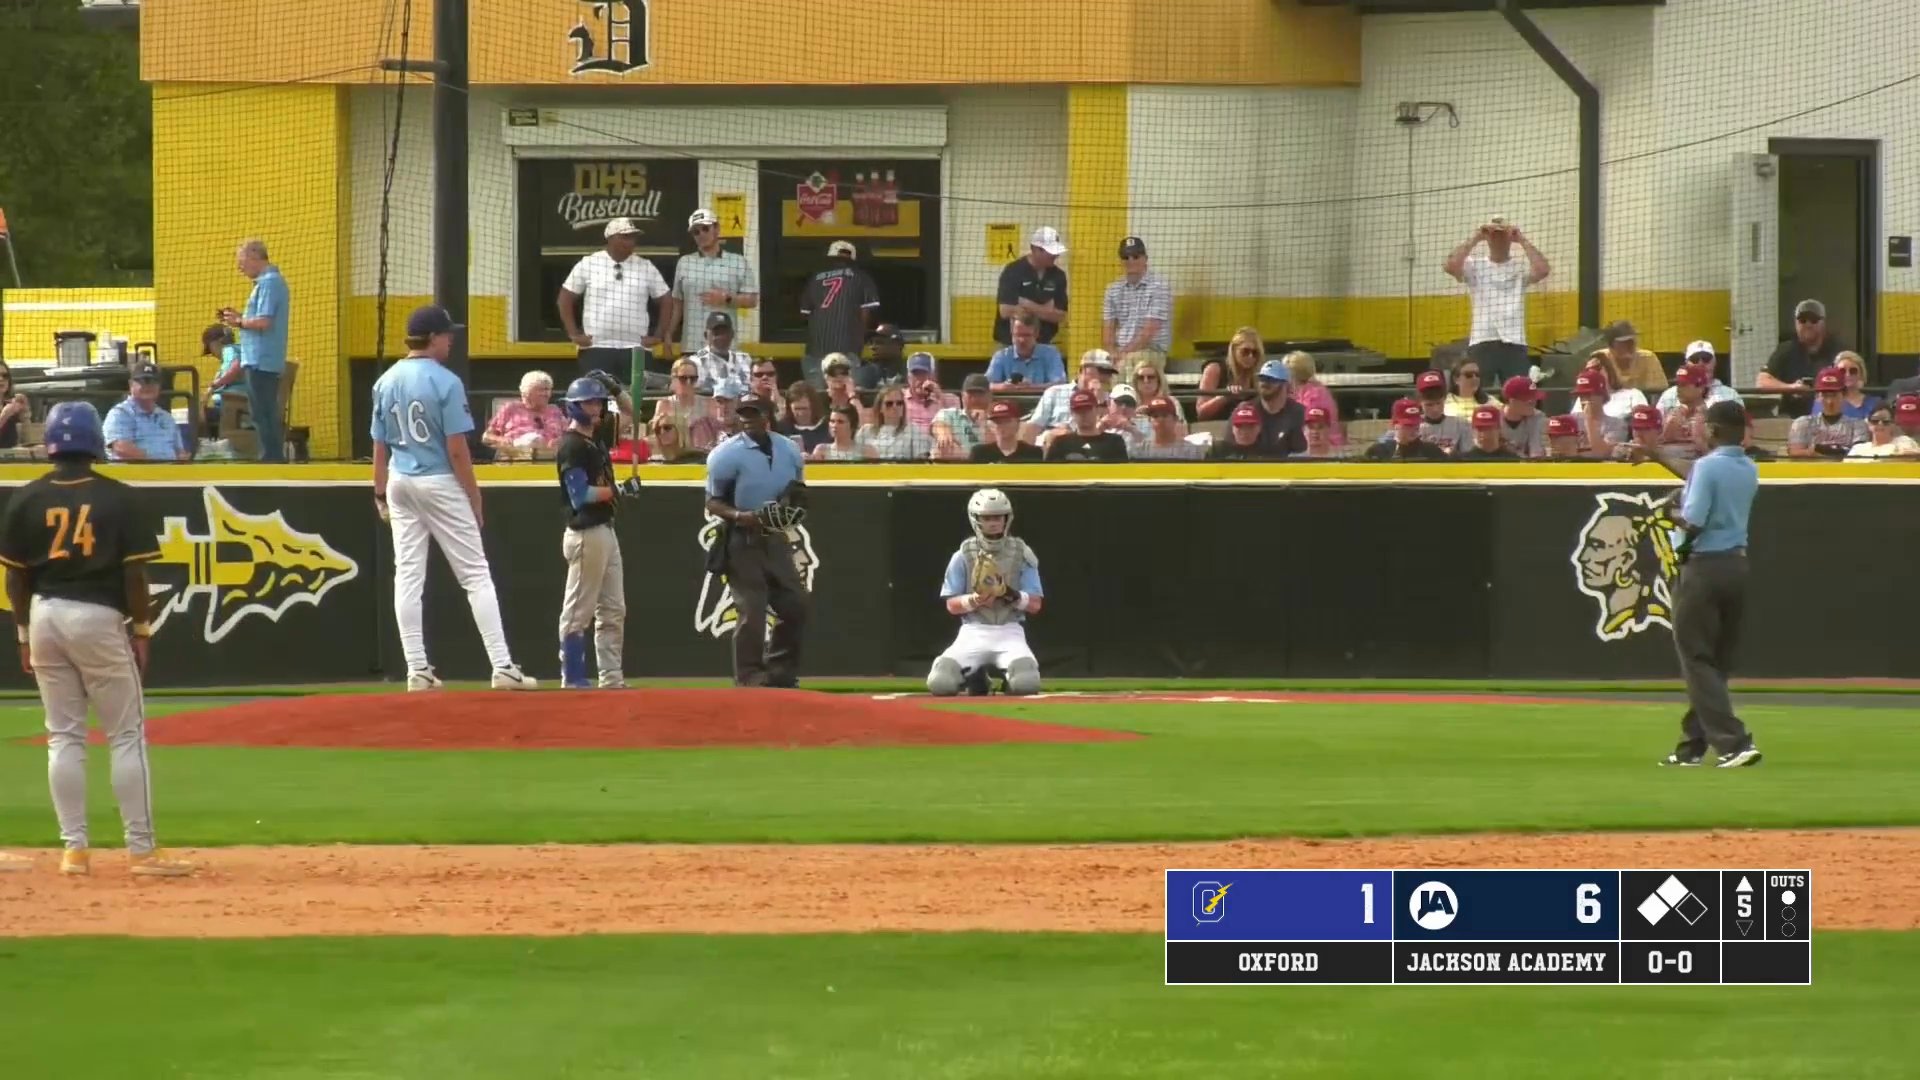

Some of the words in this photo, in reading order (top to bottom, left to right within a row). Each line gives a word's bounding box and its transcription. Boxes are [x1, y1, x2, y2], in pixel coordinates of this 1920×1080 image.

[574, 163, 647, 196] DHS
[557, 189, 662, 225] Baseball
[820, 276, 843, 309] 7
[390, 400, 431, 446] 16
[45, 503, 96, 560] 24
